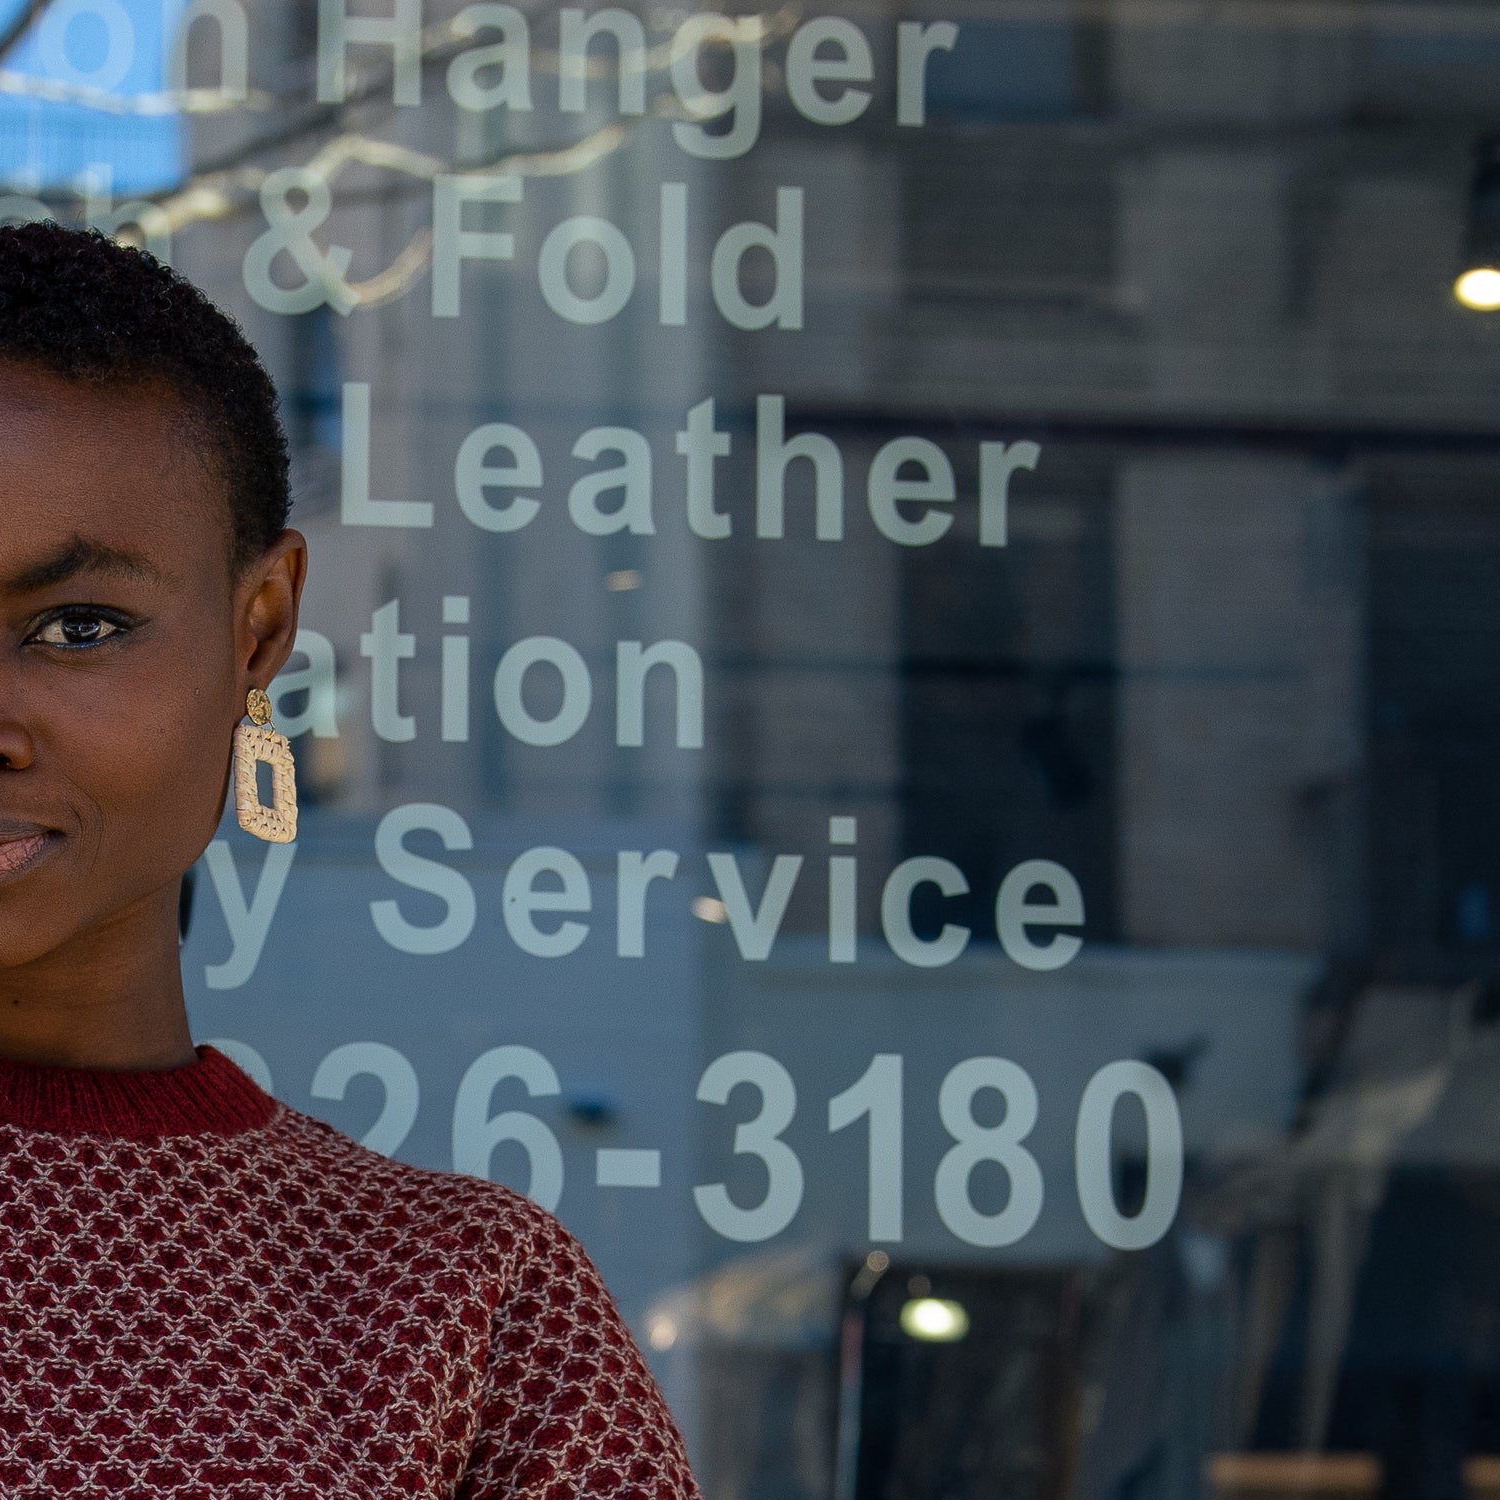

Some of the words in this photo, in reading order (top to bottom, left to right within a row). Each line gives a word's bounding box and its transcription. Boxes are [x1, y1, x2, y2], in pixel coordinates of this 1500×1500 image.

[38, 0, 248, 101] on
[316, 0, 959, 160] Hanger
[243, 166, 361, 316] &
[431, 174, 805, 331] Fold
[340, 382, 1041, 548] Leather
[268, 595, 704, 750] ation
[369, 802, 1086, 972] Service
